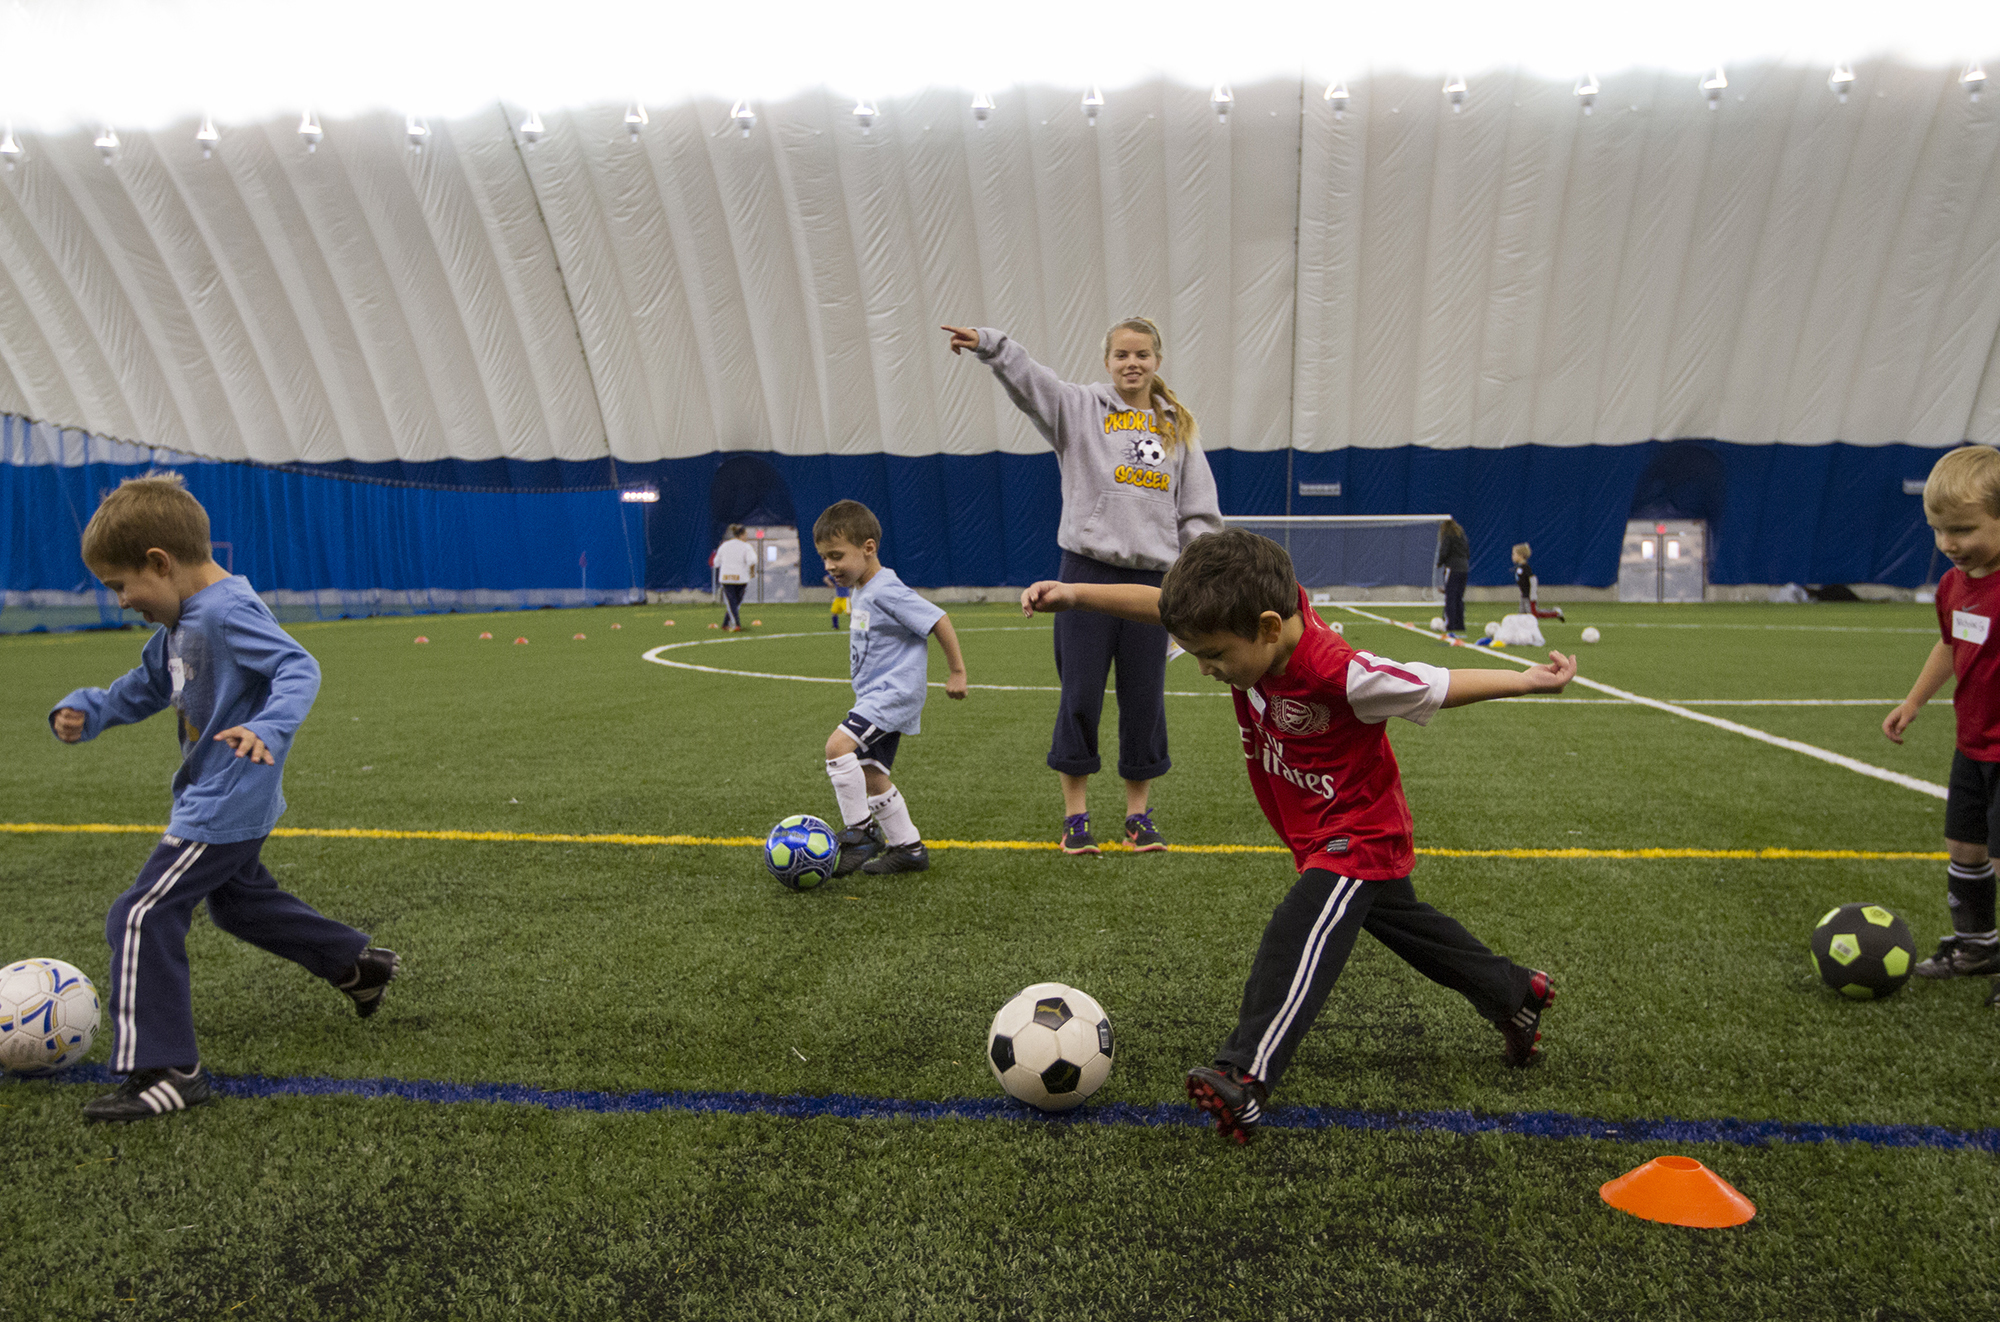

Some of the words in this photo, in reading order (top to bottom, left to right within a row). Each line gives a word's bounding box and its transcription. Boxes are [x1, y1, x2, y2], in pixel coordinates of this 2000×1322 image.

[1104, 411, 1146, 434] PRIOR
[1114, 465, 1170, 491] SOCCER
[1239, 726, 1334, 799] Eirates
